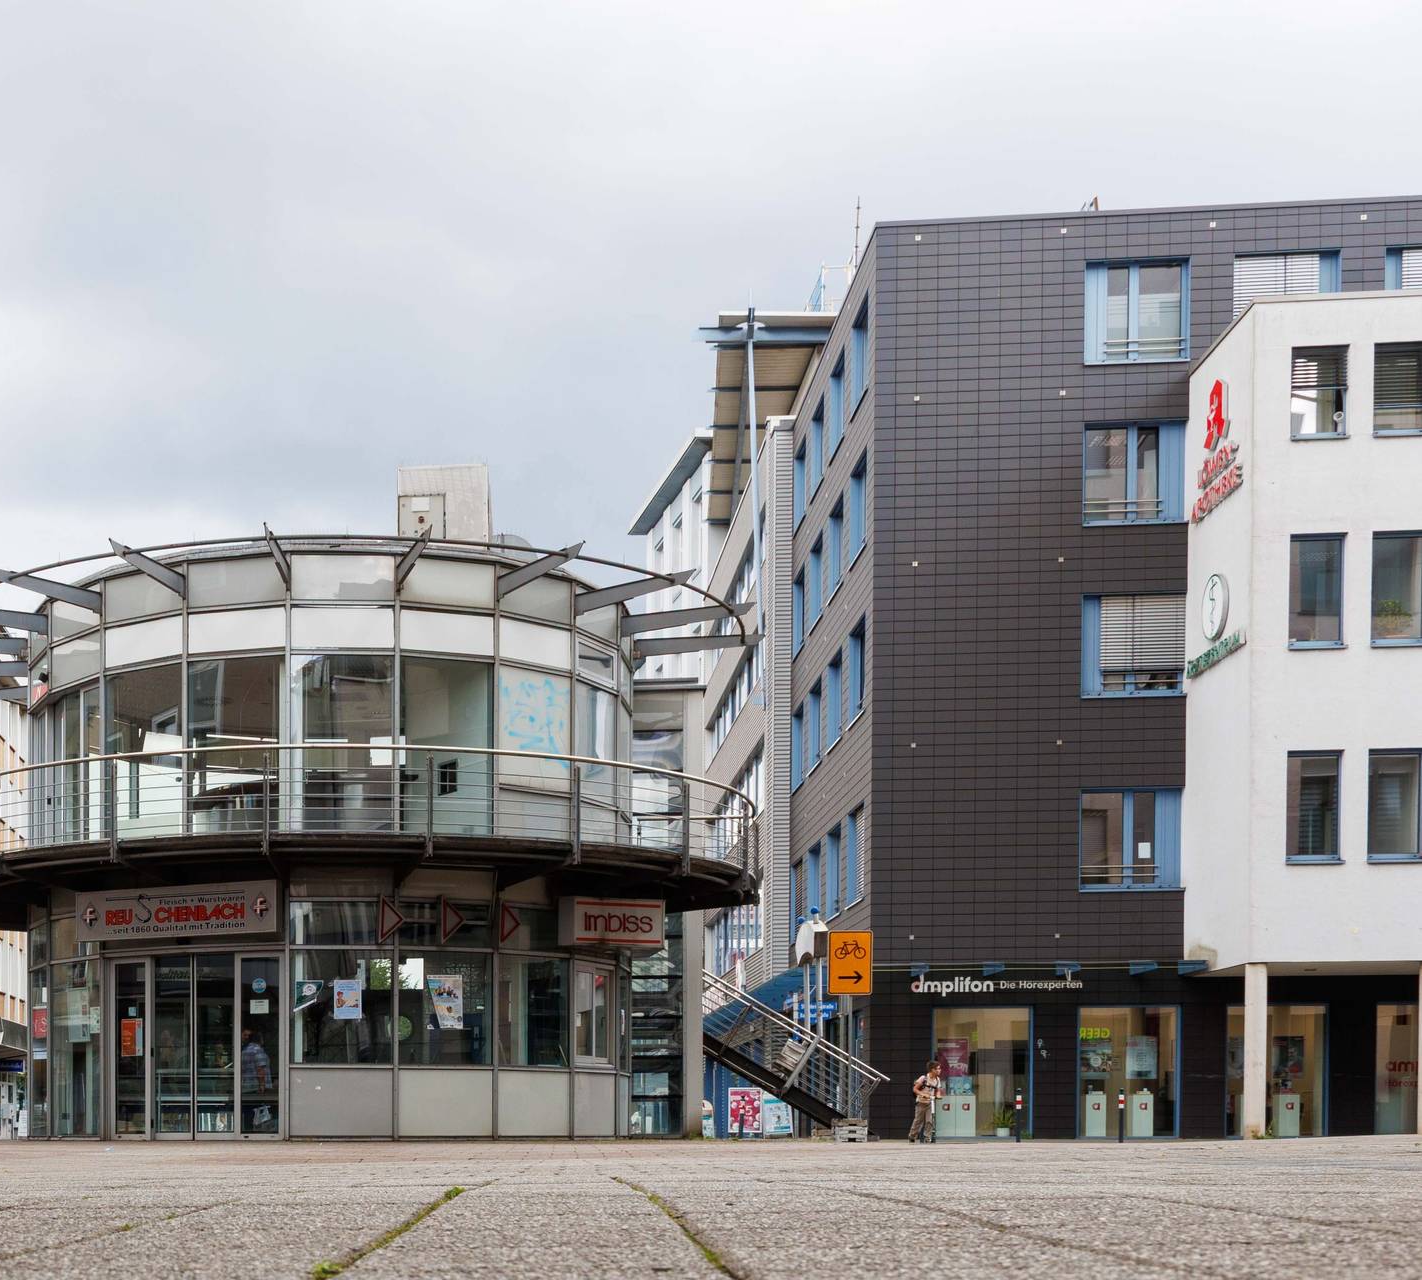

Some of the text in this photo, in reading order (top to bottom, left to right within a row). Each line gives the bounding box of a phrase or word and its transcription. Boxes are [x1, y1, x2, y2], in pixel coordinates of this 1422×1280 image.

[158, 898, 187, 906] Fleisch
[196, 894, 246, 904] Wurstwaren
[130, 925, 152, 934] 1860
[189, 923, 203, 931] mit
[204, 920, 246, 930] Tradition
[999, 980, 1016, 989] Die
